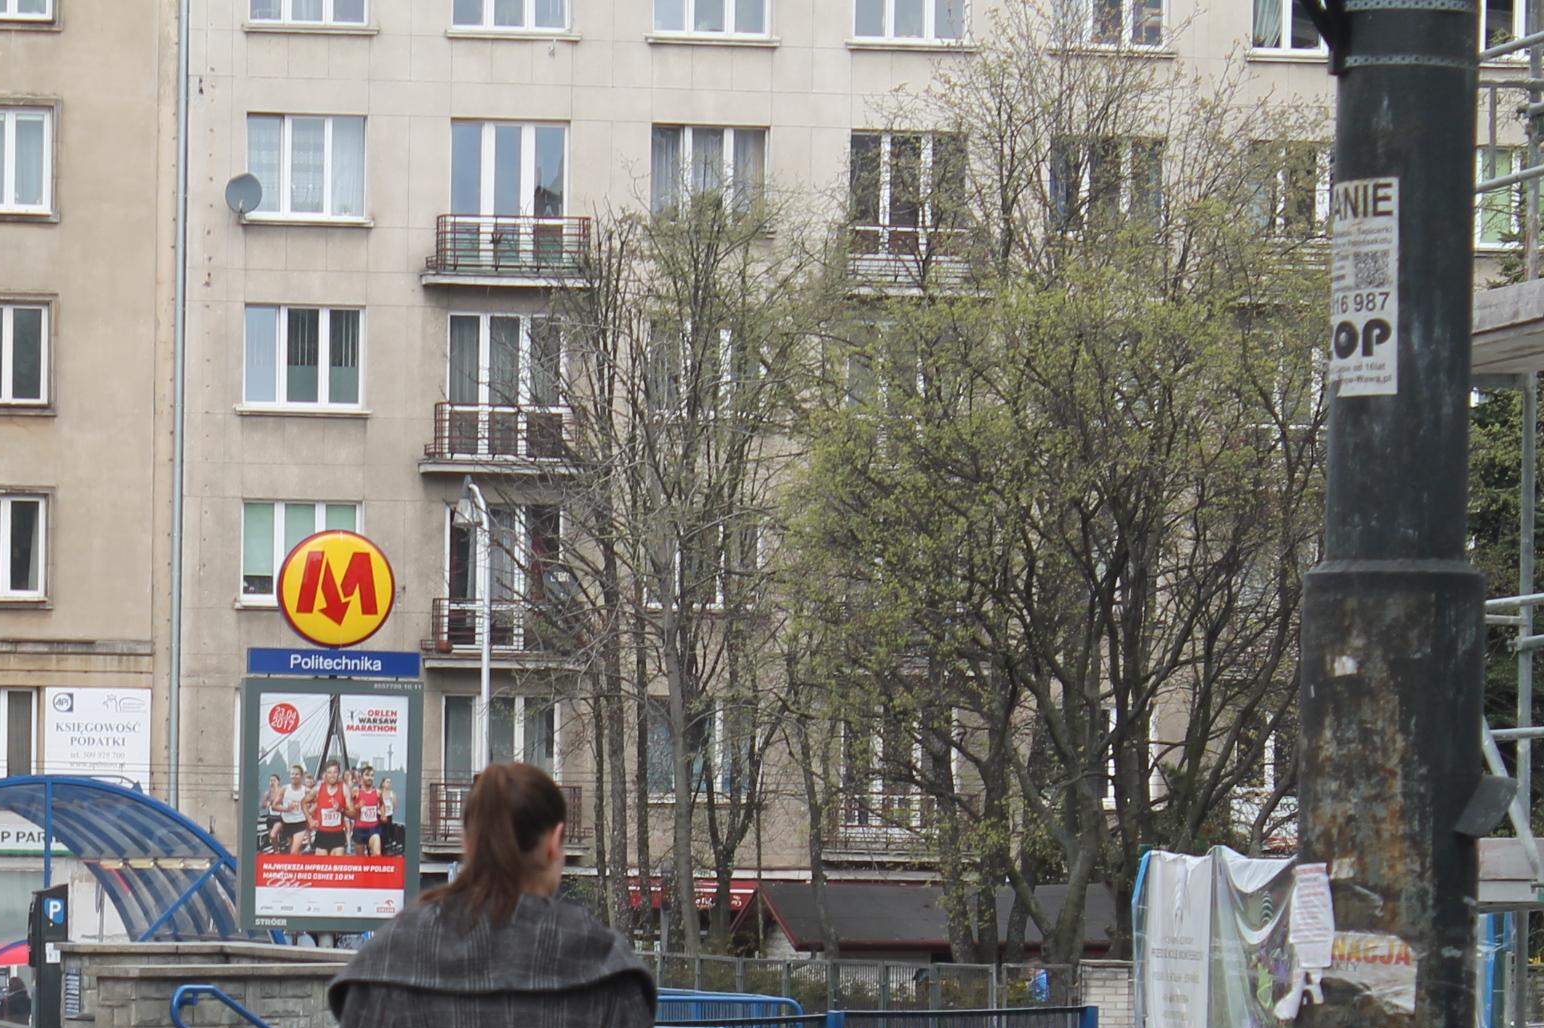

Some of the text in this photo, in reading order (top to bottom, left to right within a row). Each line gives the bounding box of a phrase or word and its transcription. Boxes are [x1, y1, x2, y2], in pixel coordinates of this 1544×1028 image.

[1354, 292, 1391, 312] 987
[290, 654, 382, 672] Politechnika
[367, 709, 398, 717] ORLEN
[56, 721, 142, 735] KSIĘGOWOŚĆ
[271, 717, 295, 732] 2017
[358, 717, 398, 725] WARSAW
[346, 724, 398, 733] MARATHON
[70, 736, 127, 747] PODATKI
[49, 901, 62, 920] P
